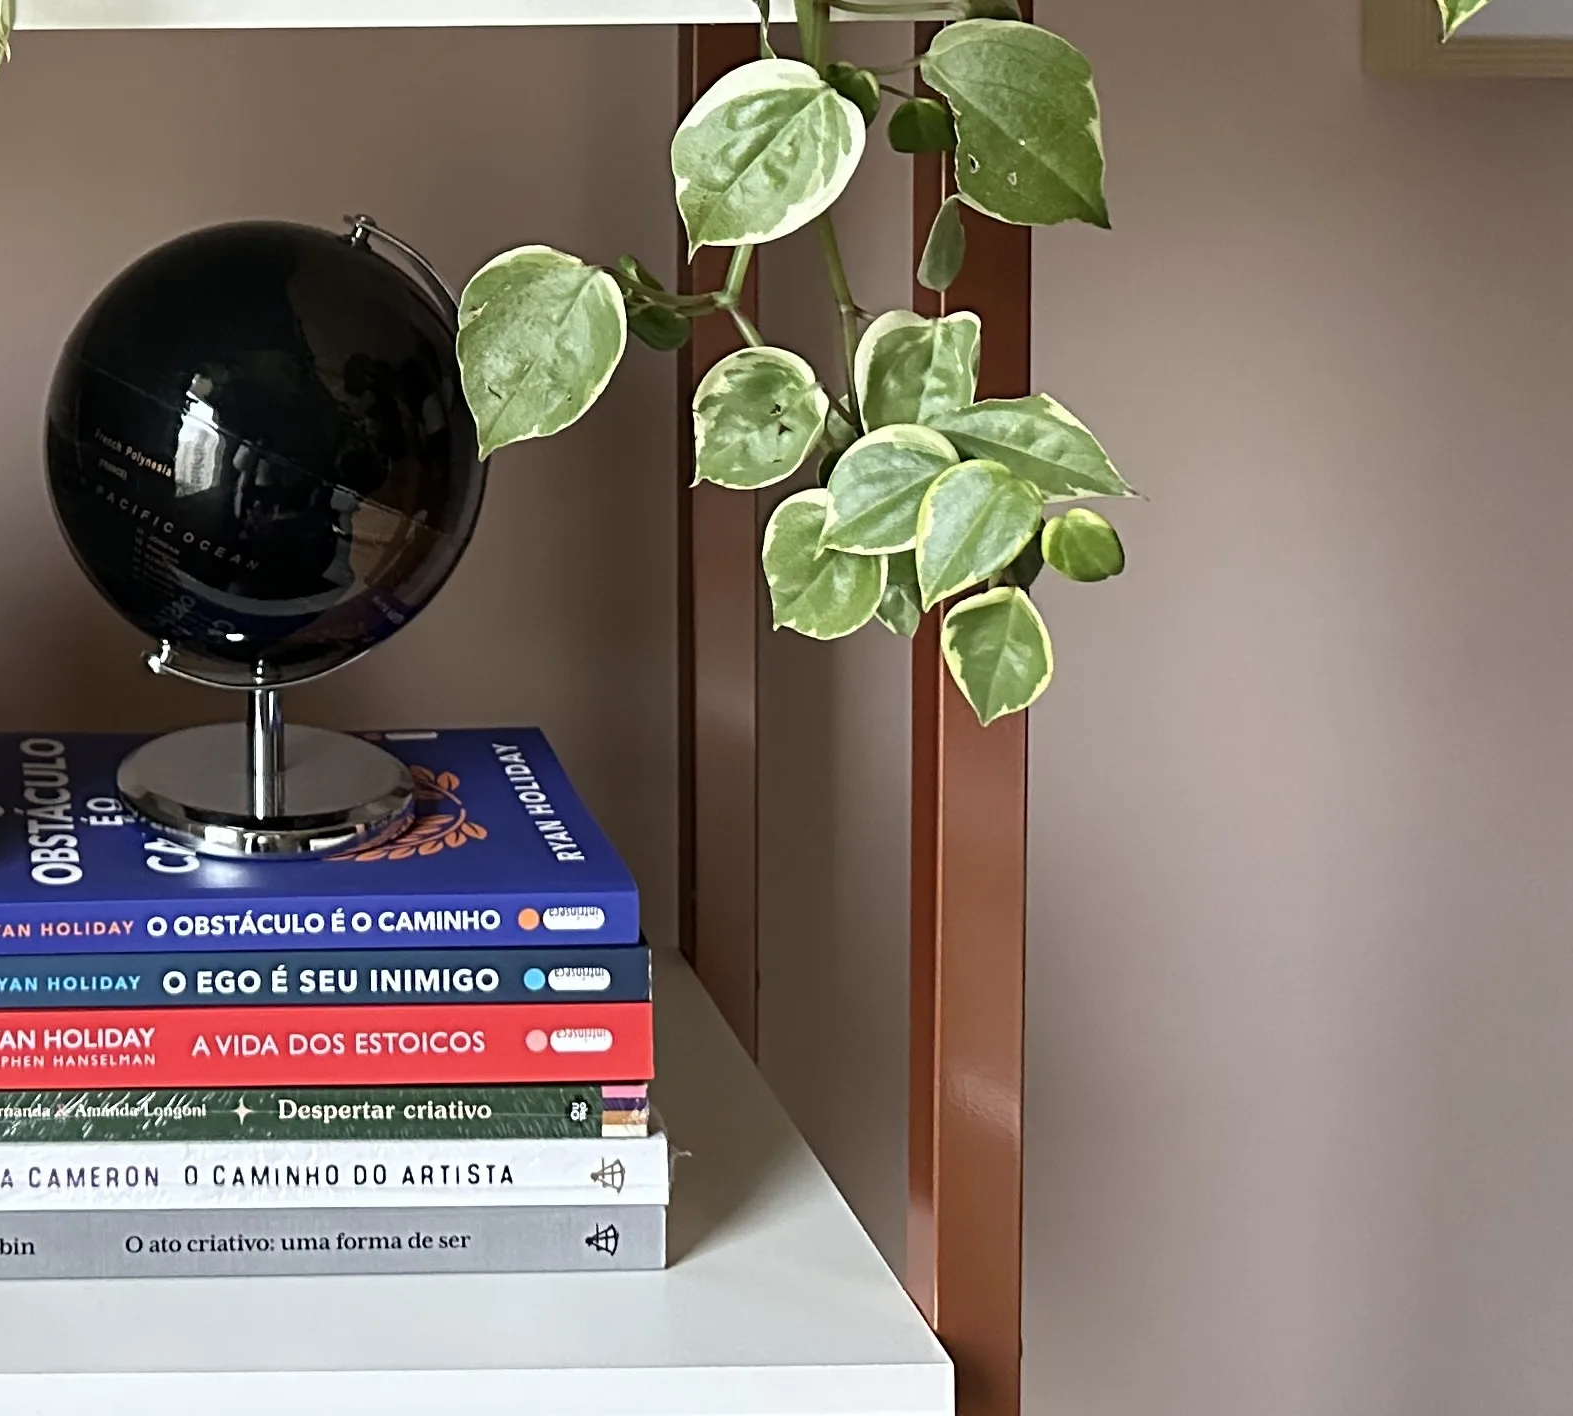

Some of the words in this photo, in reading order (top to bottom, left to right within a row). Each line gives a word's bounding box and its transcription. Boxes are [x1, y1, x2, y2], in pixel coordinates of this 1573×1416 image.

[125, 445, 173, 478] Polynesia
[95, 485, 175, 534] PACIFIC
[183, 531, 261, 571] OCEAN
[13, 737, 84, 886] OBSTÁCULO
[85, 796, 123, 813] O
[491, 742, 556, 816] HOLIDAY
[534, 819, 586, 862] RYAN
[79, 815, 124, 827] É
[40, 920, 135, 938] HOLIDAY
[146, 916, 168, 937] O
[173, 910, 326, 937] OBSTÁCULO
[351, 912, 373, 933] O
[377, 908, 502, 932] CAMINHO
[46, 975, 142, 993] HOLIDAY
[162, 971, 187, 995] O
[196, 970, 263, 995] EGO
[299, 968, 359, 994] SEU
[369, 967, 501, 993] INIMIGO
[43, 1026, 157, 1049] HOLIDAY
[215, 1034, 280, 1057] VIDA
[288, 1032, 346, 1056] DOS
[354, 1030, 487, 1054] ESTOICOS
[52, 1052, 157, 1067] HANSELMAN
[277, 1098, 396, 1124] Despertar
[402, 1098, 493, 1120] criativo
[28, 1164, 160, 1189] CAMERON
[212, 1163, 340, 1186] CAMINHO
[352, 1163, 388, 1186] DO
[401, 1162, 516, 1186] ARTISTA
[148, 1236, 183, 1254] ato
[280, 1235, 330, 1252] uma
[335, 1231, 402, 1251] forma
[407, 1231, 434, 1250] de
[437, 1234, 473, 1250] ser
